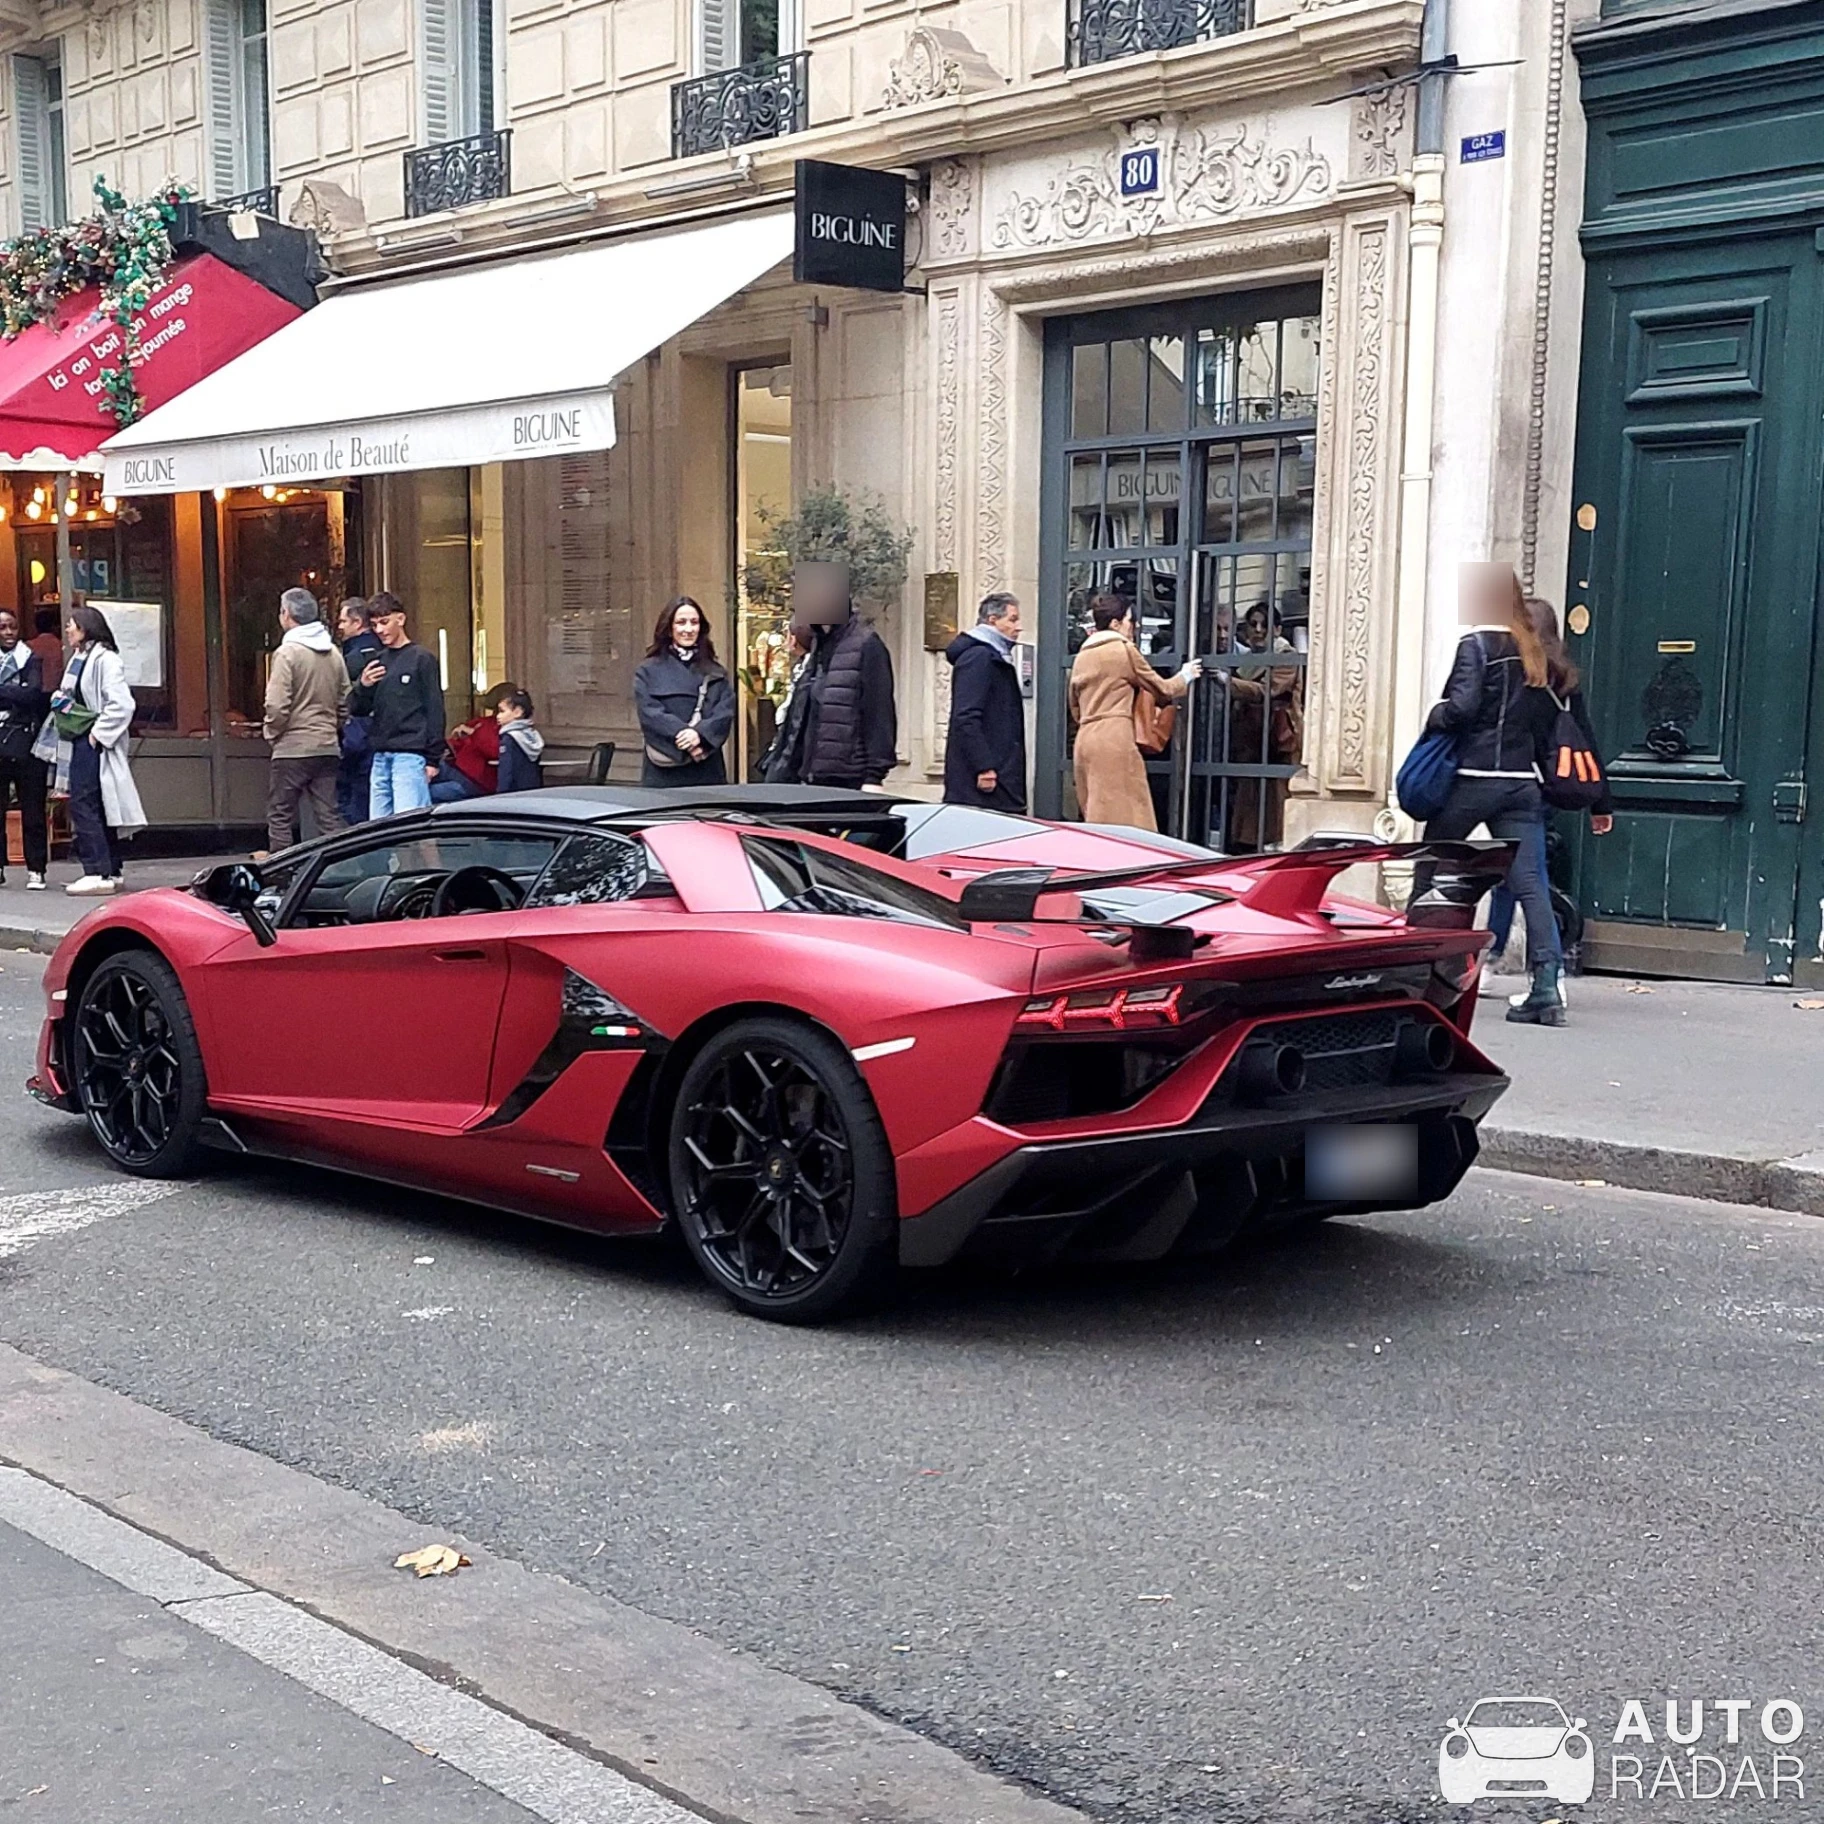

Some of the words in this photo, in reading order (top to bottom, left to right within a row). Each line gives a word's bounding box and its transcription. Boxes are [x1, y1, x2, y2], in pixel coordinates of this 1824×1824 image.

[1471, 135, 1495, 150] GAZ
[1125, 154, 1153, 187] 80
[811, 212, 897, 250] BIGUINE
[46, 369, 69, 391] Ici
[71, 356, 92, 376] on
[89, 332, 121, 360] boit
[149, 283, 194, 320] mange
[514, 408, 582, 445] BIGUINE
[124, 457, 176, 484] BIGUINE
[258, 443, 319, 478] Maison
[323, 439, 344, 471] de
[350, 434, 410, 468] Beauté
